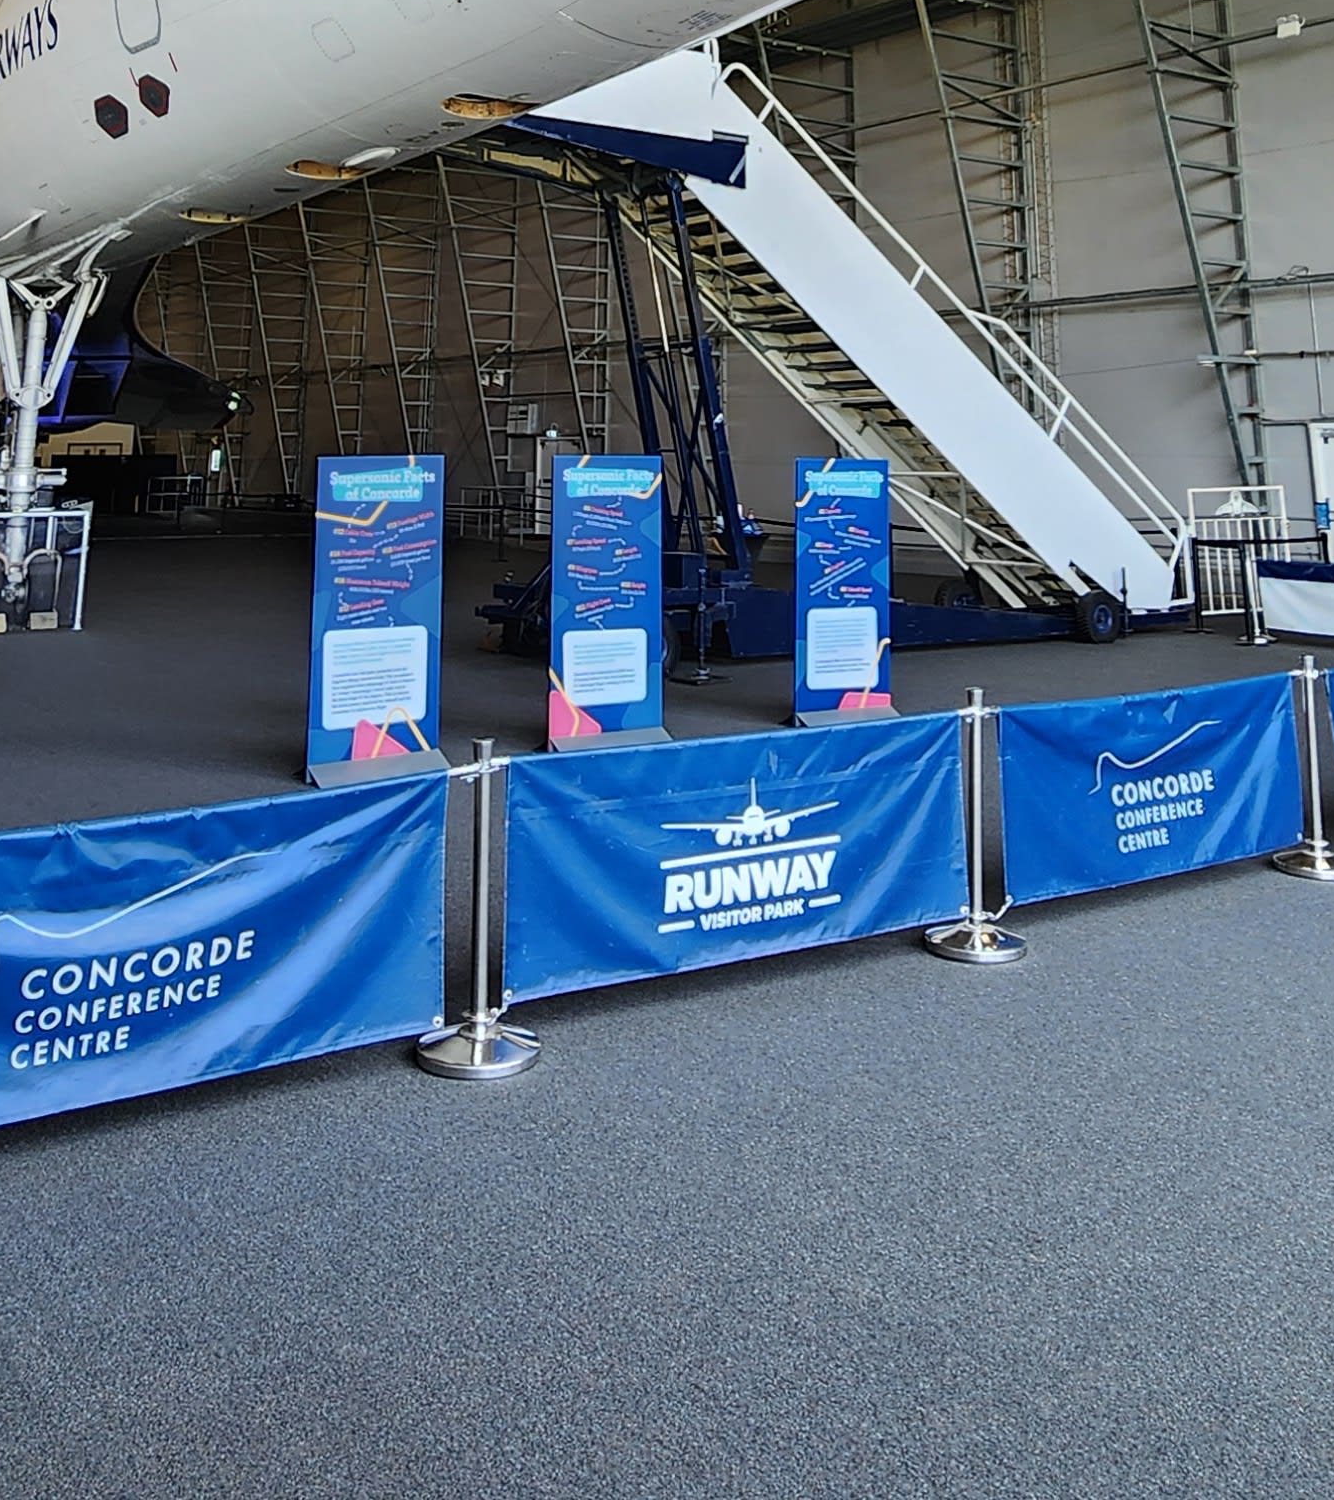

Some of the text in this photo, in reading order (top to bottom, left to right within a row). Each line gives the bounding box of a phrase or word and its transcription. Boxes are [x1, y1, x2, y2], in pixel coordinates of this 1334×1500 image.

[330, 470, 436, 487] Supersonic Facts
[563, 468, 655, 484] Supersonic Facts
[577, 484, 643, 496] of Concorde
[805, 470, 884, 484] Supersonic Facts
[817, 484, 874, 496] of Concorde
[346, 485, 420, 499] of Concorde
[1111, 769, 1215, 807] CONCORDE
[1116, 798, 1205, 830] CONFERENCE
[1118, 827, 1170, 853] CENTRE
[664, 850, 837, 914] RUNWAY
[699, 898, 805, 932] VISITOR PARK
[20, 930, 255, 1000] CONCORDE
[14, 974, 222, 1034] CONFERENCE
[10, 1025, 131, 1070] CENTRE
